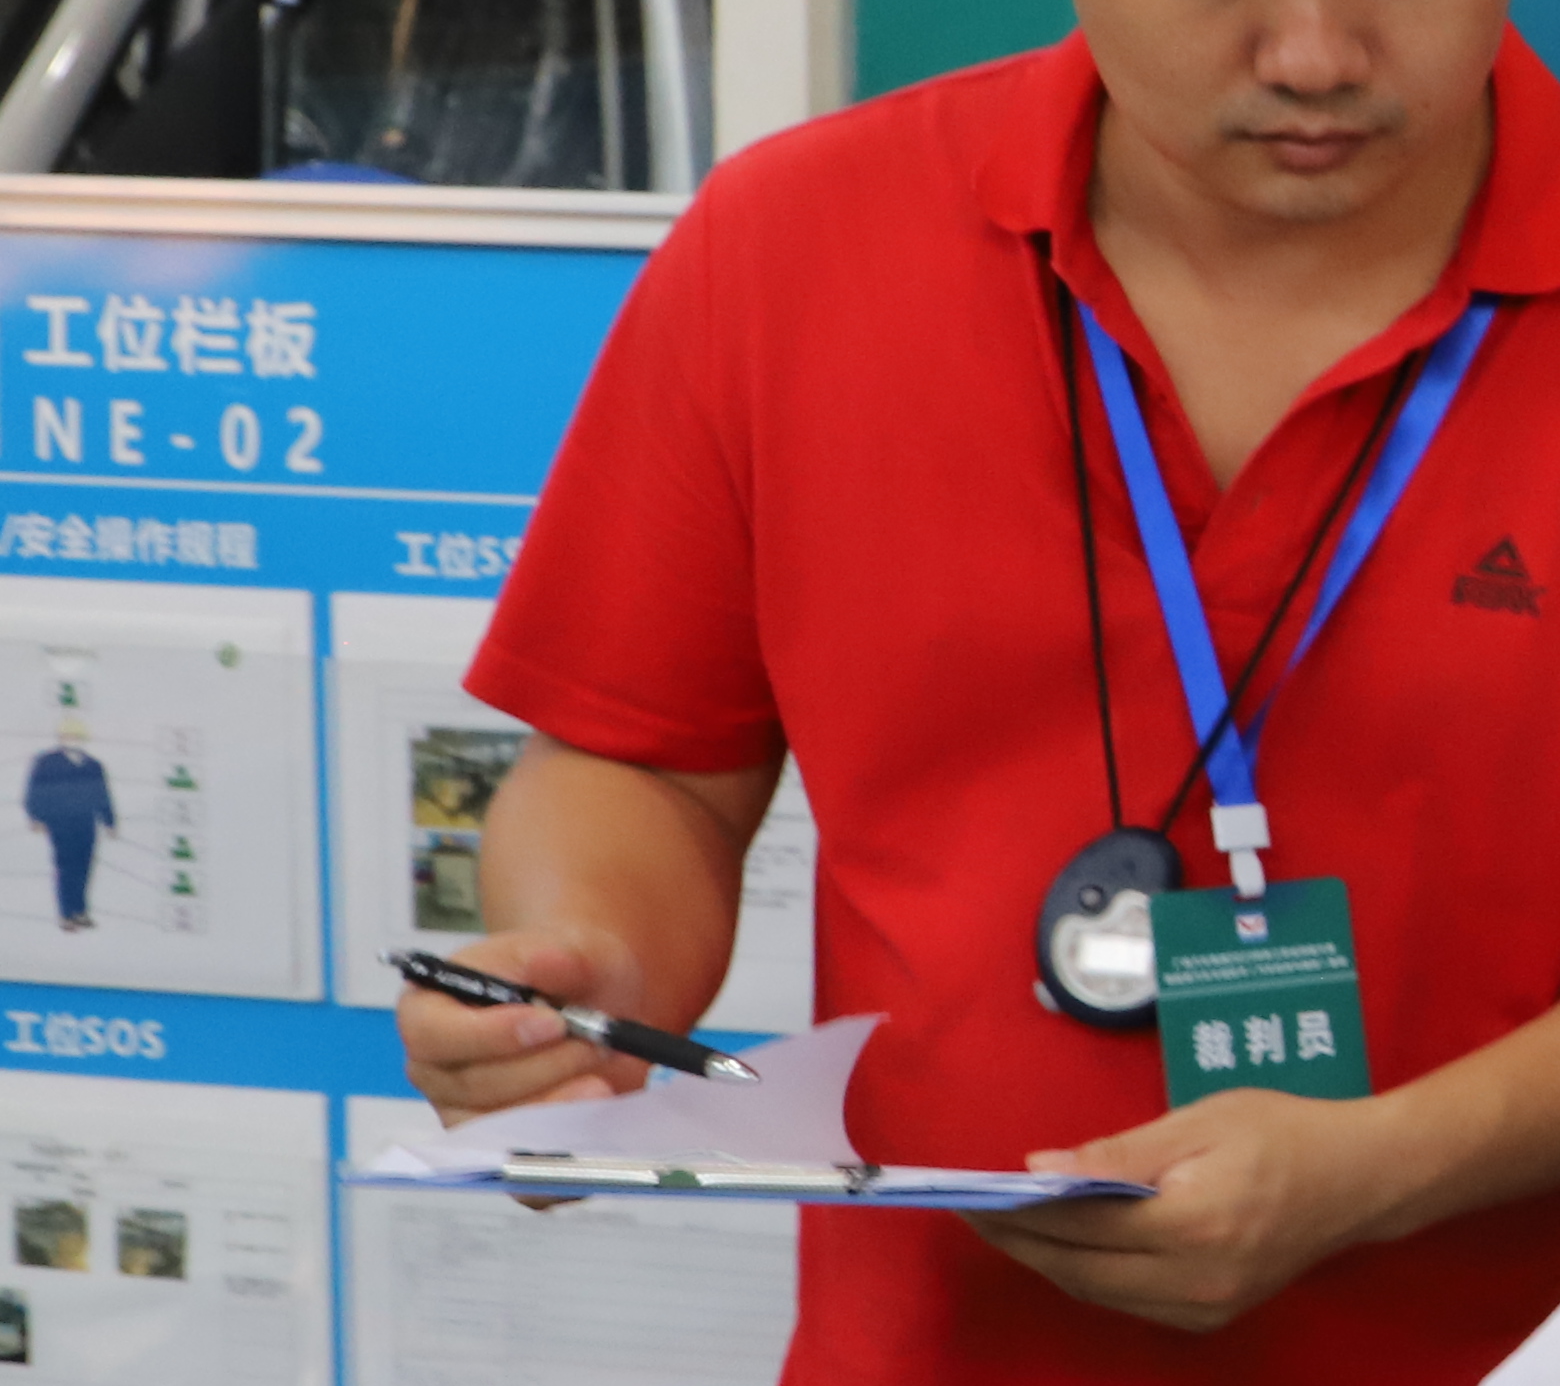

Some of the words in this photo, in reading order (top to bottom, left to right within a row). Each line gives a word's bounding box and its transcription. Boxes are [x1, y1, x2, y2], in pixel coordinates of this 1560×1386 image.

[22, 294, 319, 379] 工位栏板
[4, 1010, 167, 1060] 工位SOS
